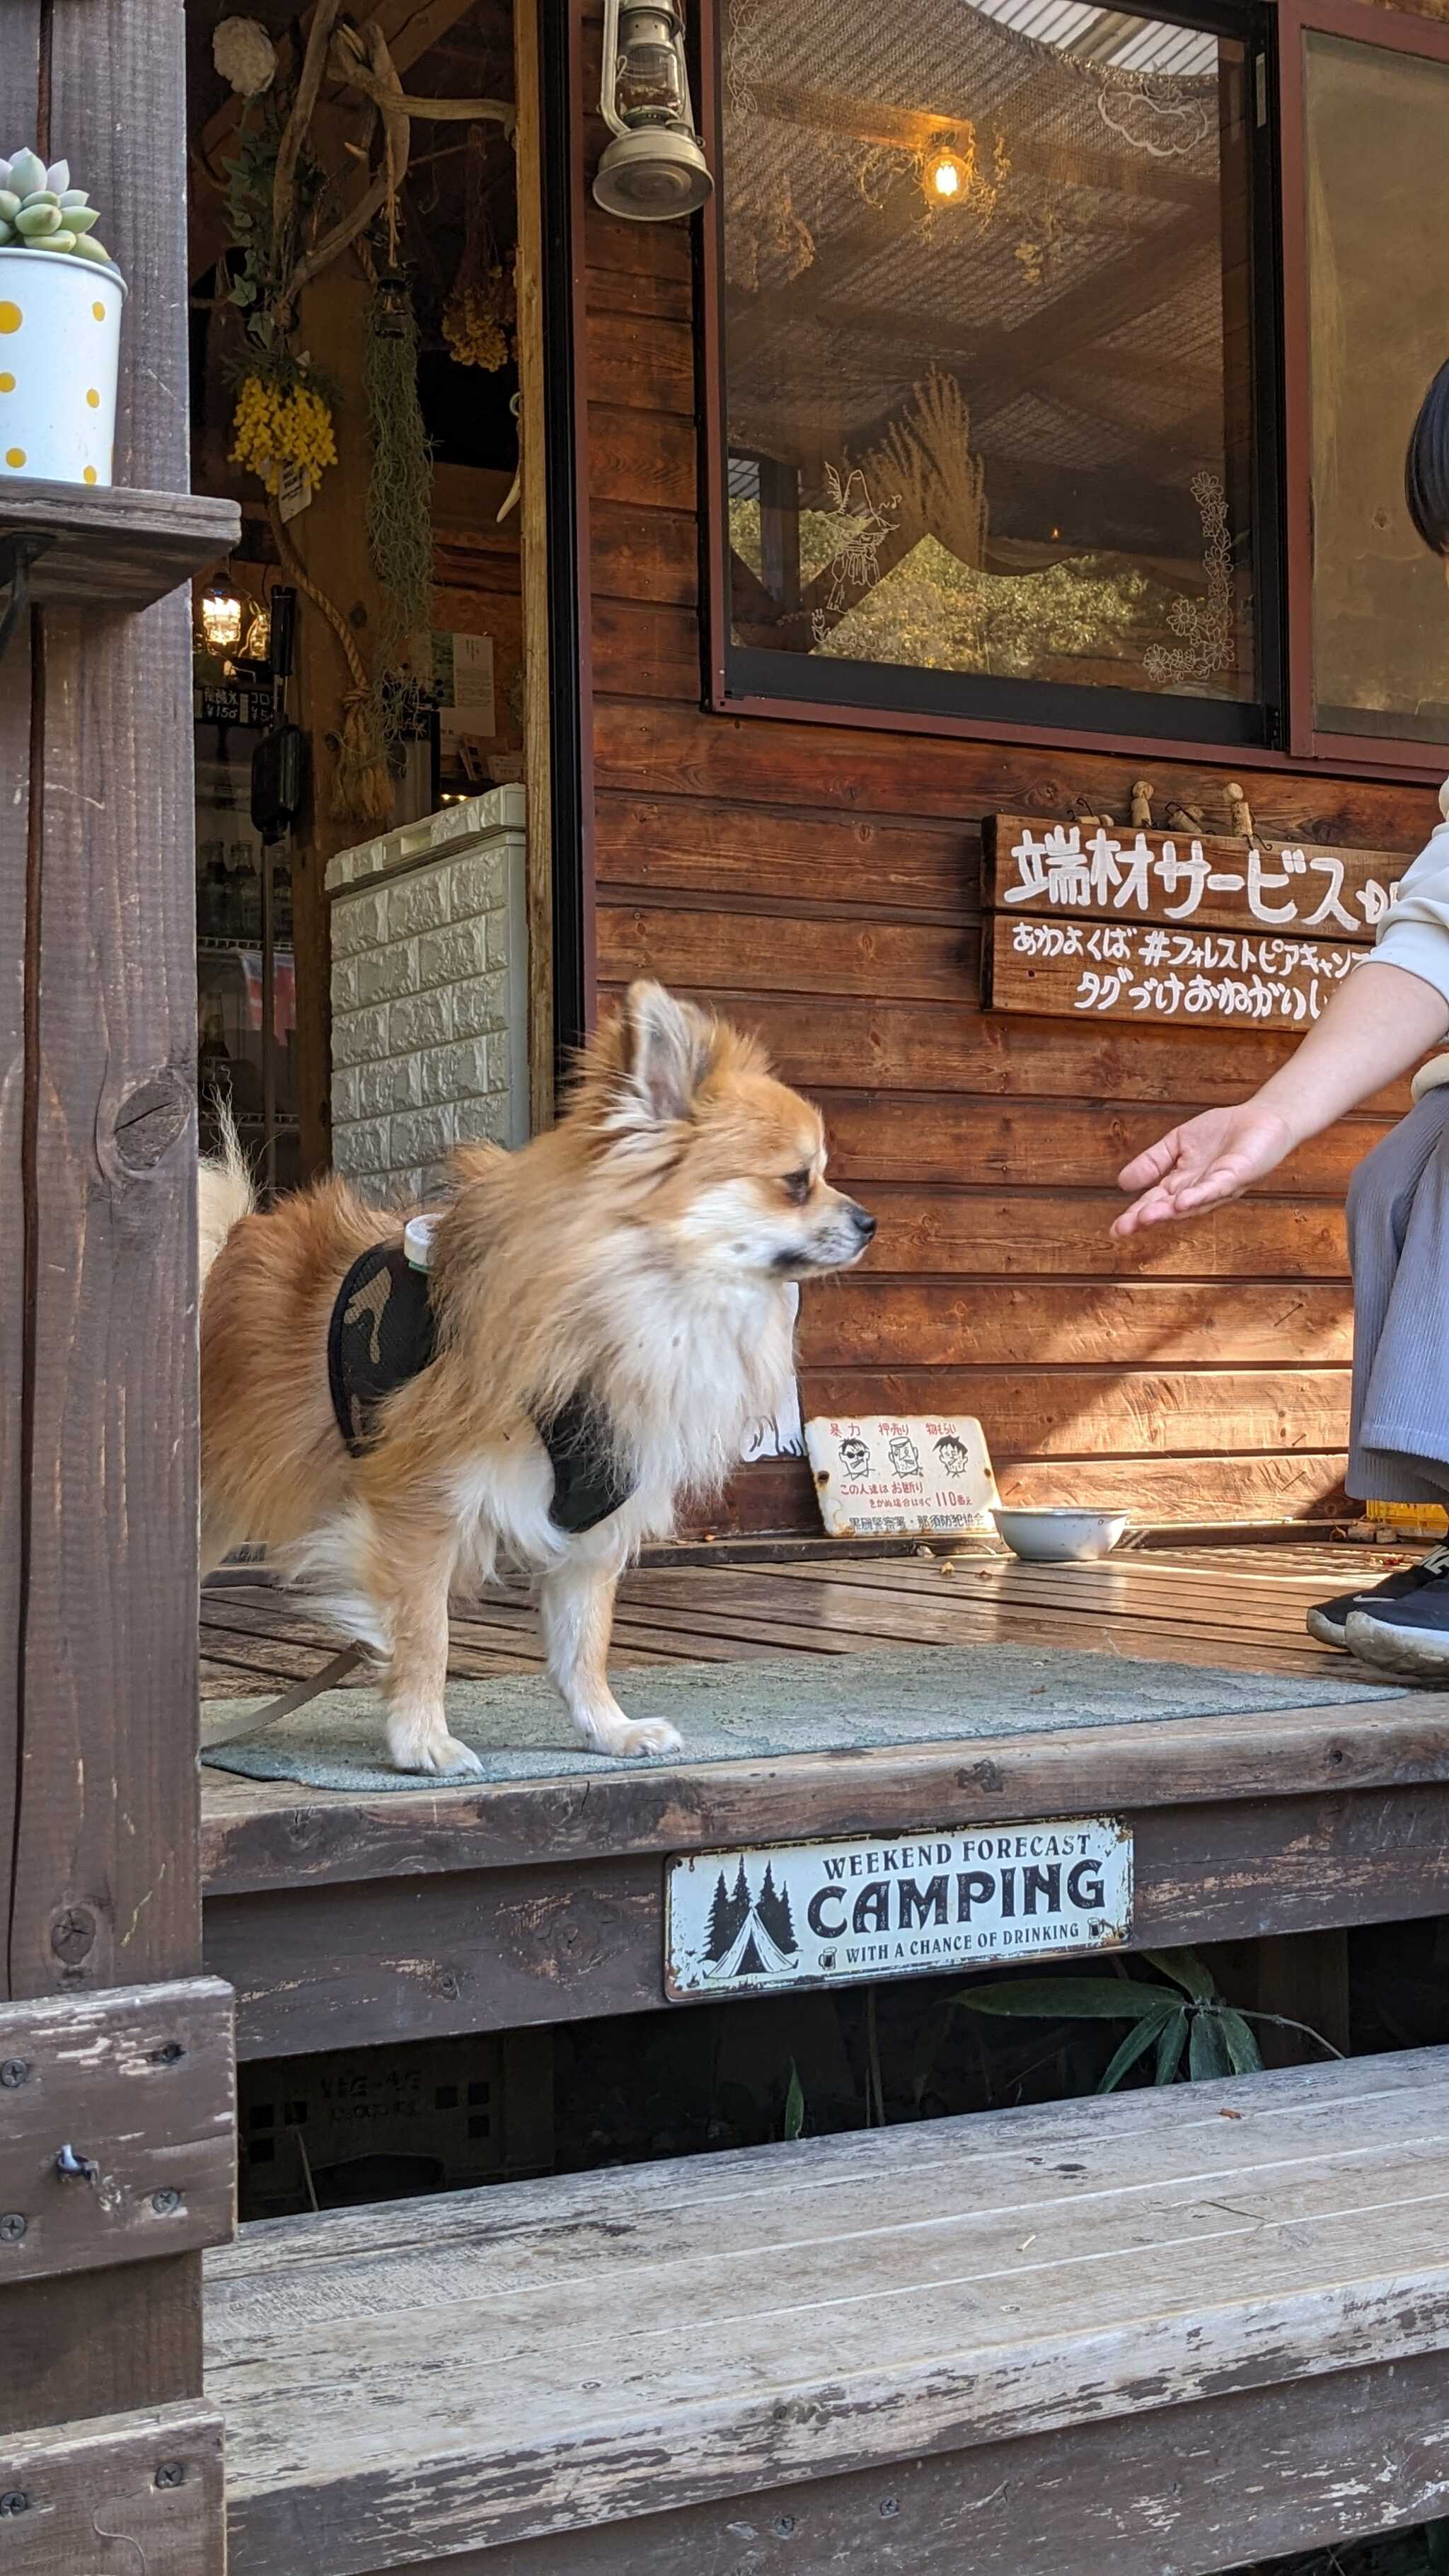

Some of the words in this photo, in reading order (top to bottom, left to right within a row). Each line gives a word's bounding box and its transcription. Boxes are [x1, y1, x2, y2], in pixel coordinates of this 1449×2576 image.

[823, 1844, 952, 1880] WEEKEND
[963, 1834, 1091, 1862] FORECAST
[807, 1859, 1106, 1939] CAMPING
[845, 1944, 889, 1964] WITH
[894, 1943, 904, 1958] A
[910, 1935, 972, 1956] CHANCE
[978, 1932, 997, 1949] OF
[1003, 1923, 1079, 1946] DRINKING
